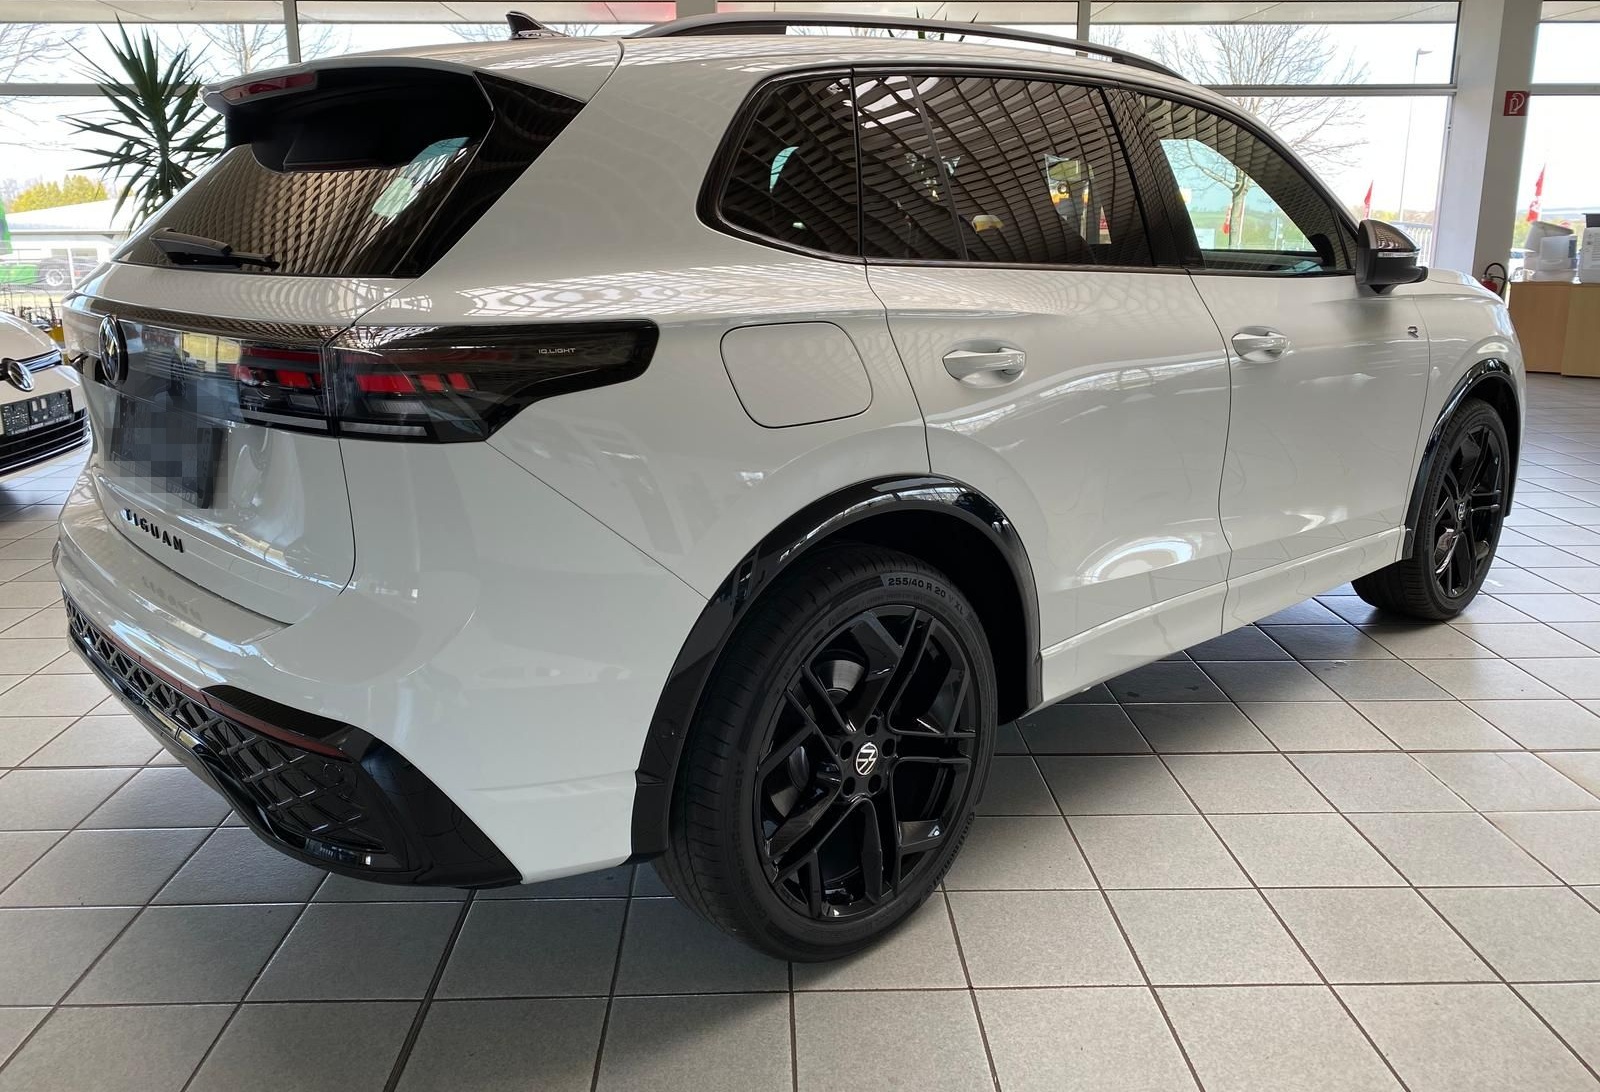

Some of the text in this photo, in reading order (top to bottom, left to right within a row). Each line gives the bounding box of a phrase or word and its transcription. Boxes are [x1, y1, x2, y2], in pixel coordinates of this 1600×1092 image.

[538, 347, 576, 355] IQ.LIGHT
[123, 507, 184, 554] TIGUAN
[888, 577, 924, 589] 255/40
[926, 582, 933, 592] R
[934, 586, 946, 598] 20
